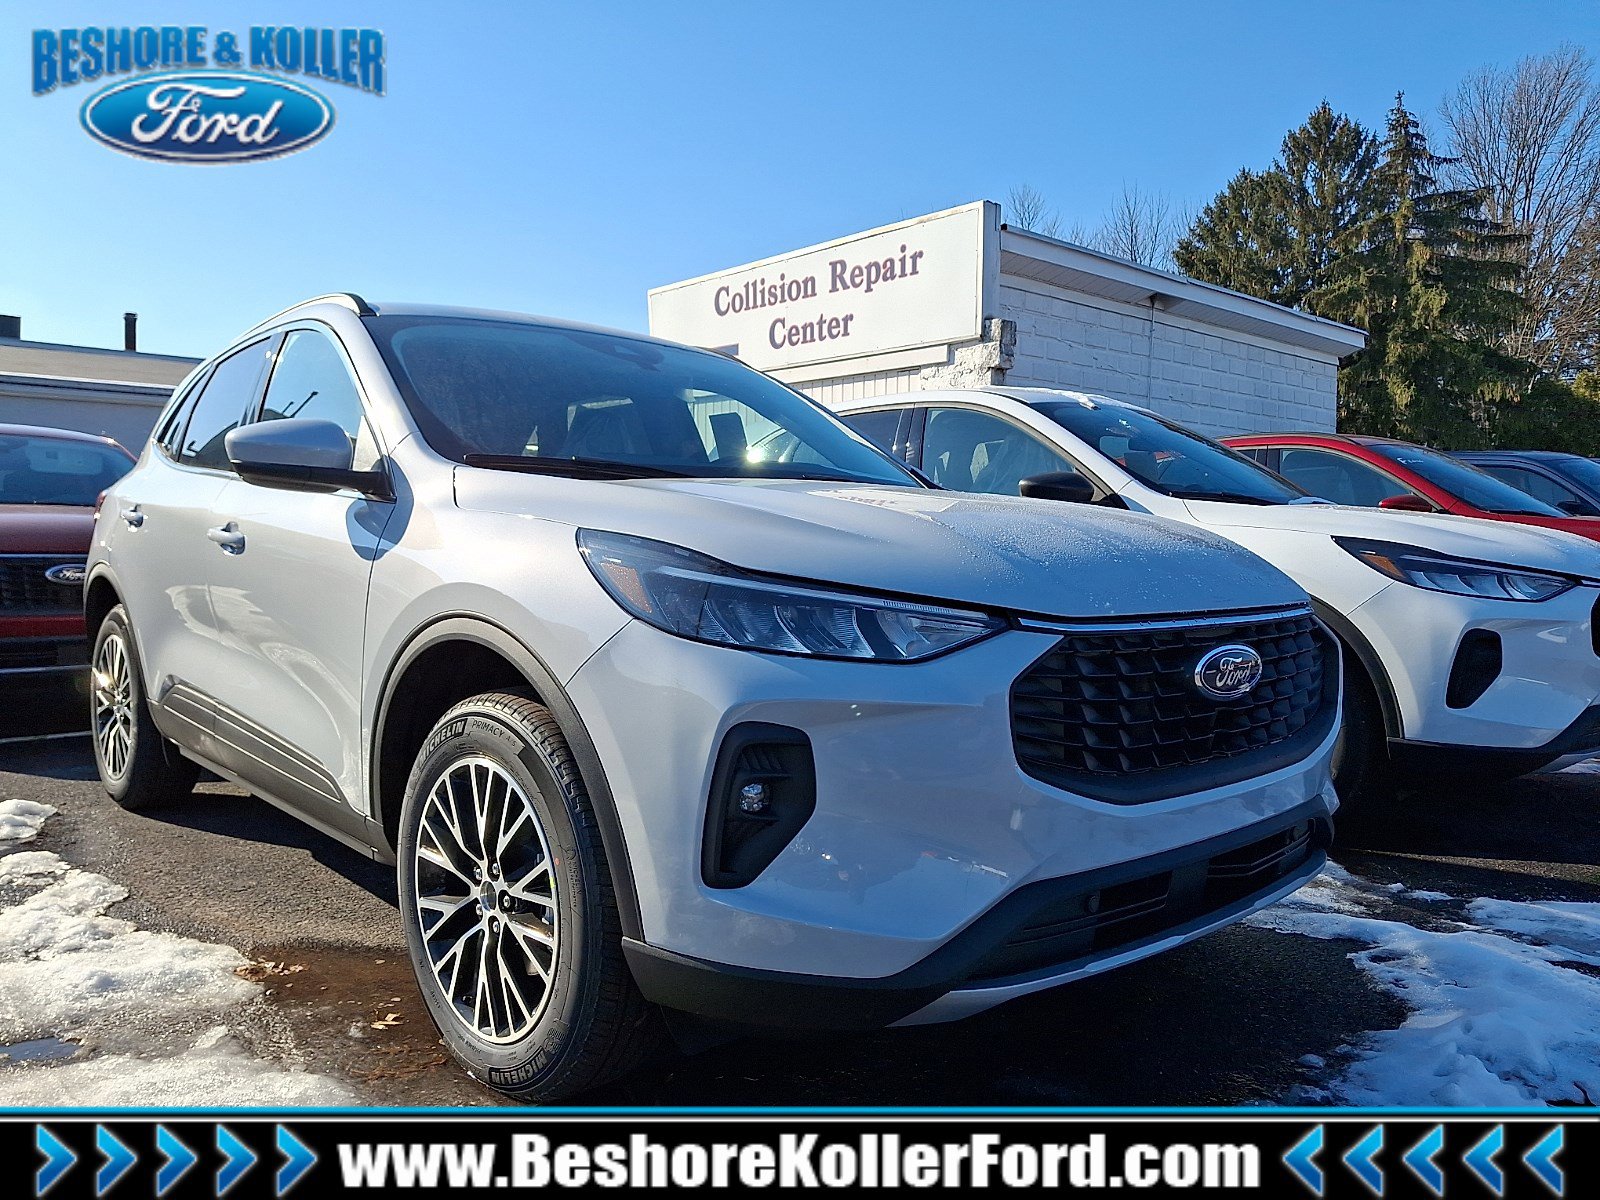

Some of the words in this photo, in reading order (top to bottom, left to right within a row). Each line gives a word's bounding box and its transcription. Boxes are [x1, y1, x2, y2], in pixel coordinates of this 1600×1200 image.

[714, 273, 818, 317] Collision
[828, 244, 925, 294] Repair
[768, 313, 854, 350] Center
[1215, 657, 1252, 687] Ford
[419, 719, 466, 763] MICHELIN
[471, 720, 505, 738] PRIMACY
[490, 1050, 548, 1085] MICHELIN
